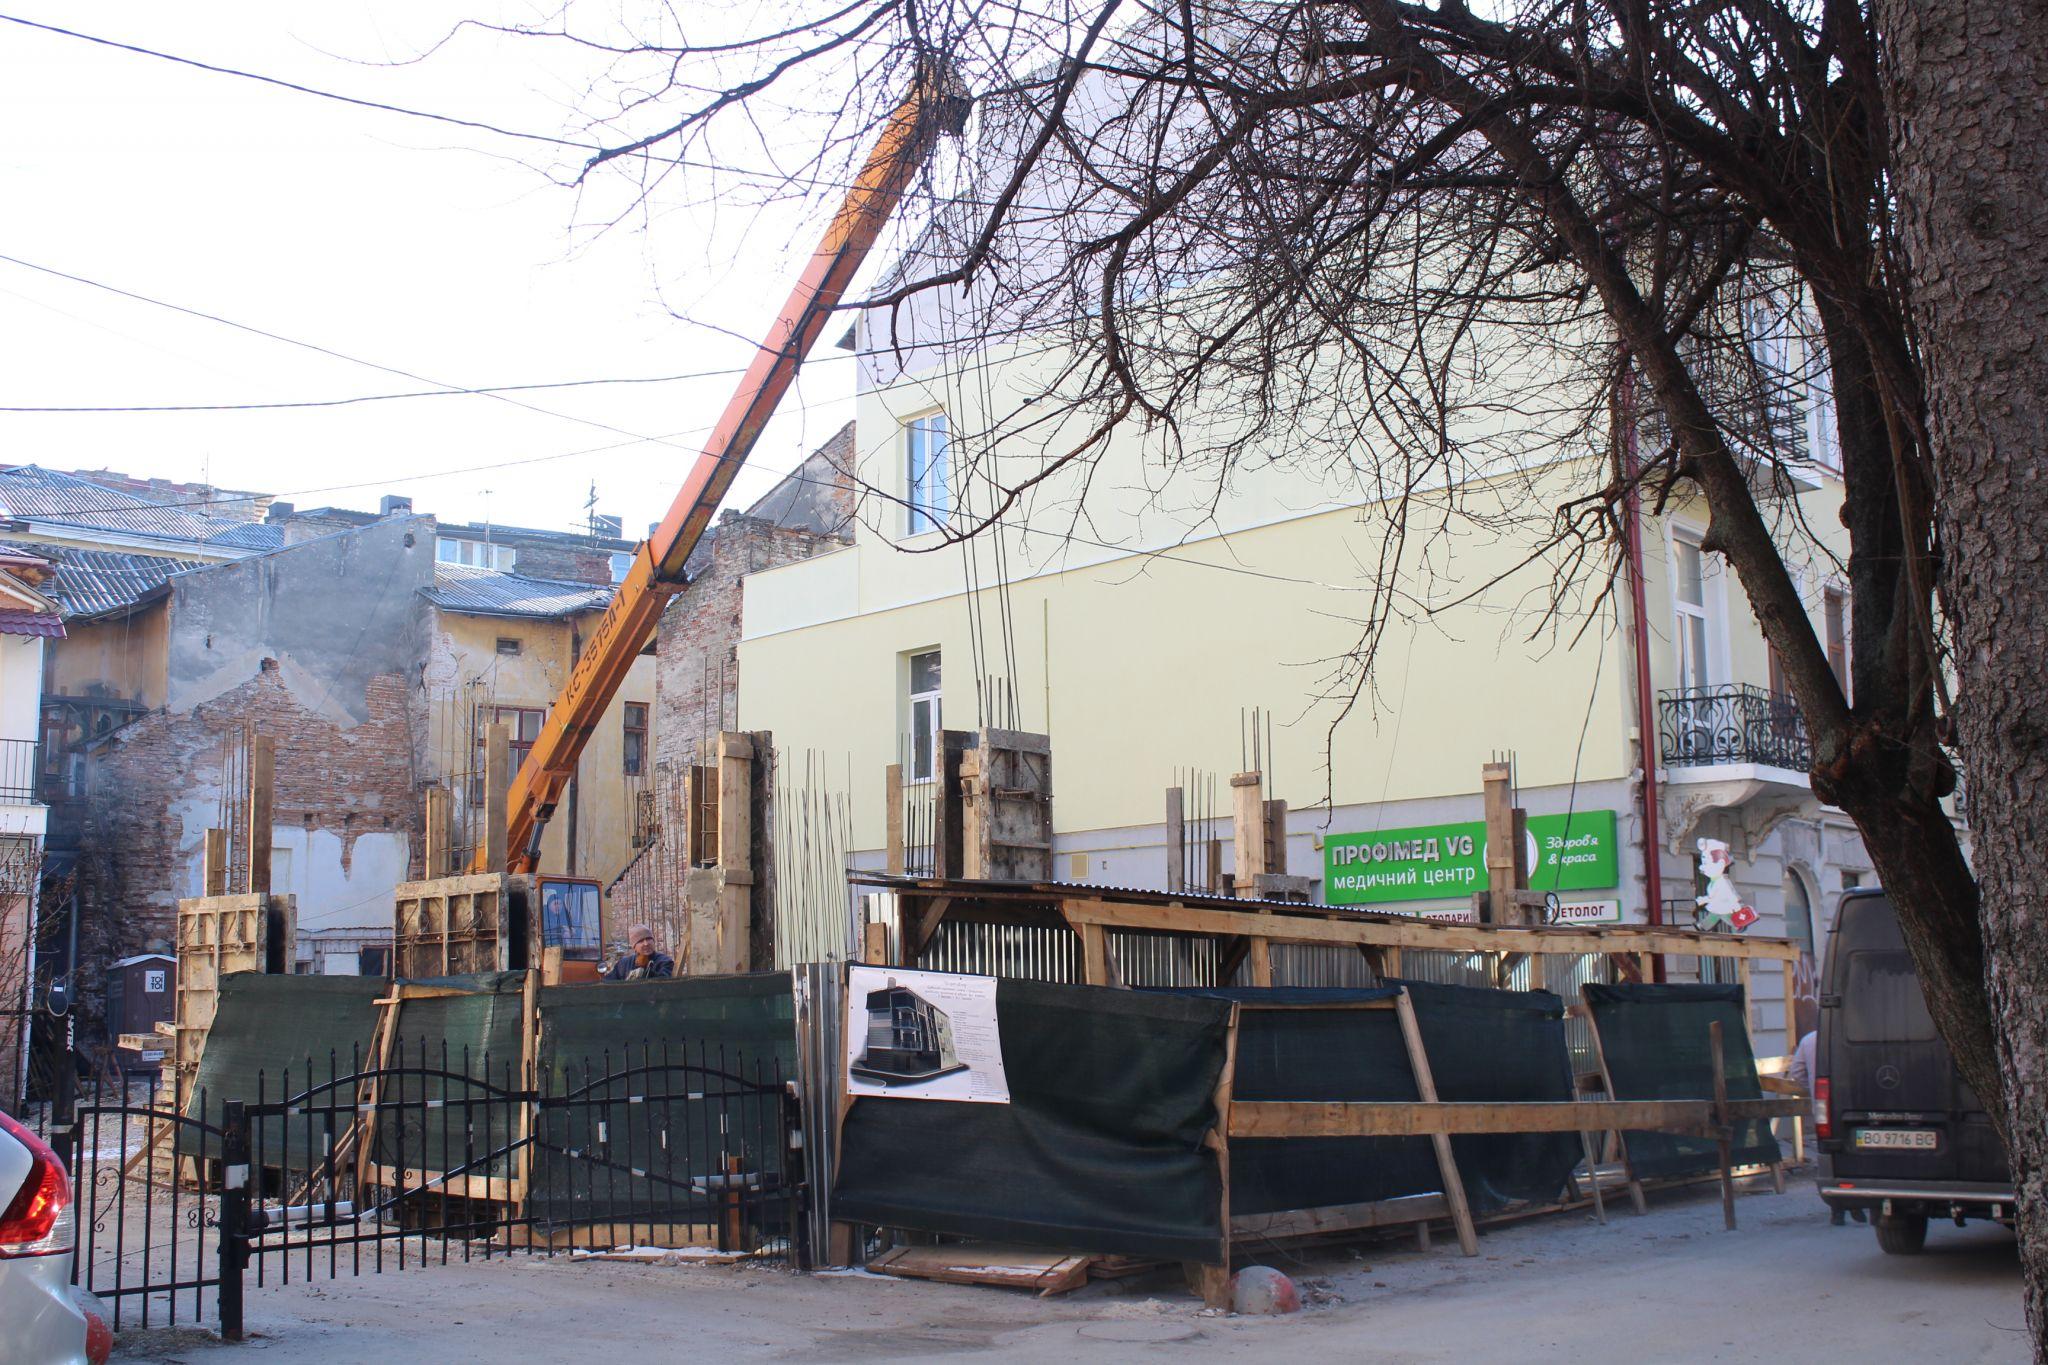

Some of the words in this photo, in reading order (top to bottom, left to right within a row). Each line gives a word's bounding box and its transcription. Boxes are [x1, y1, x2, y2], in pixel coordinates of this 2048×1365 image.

[1332, 838, 1440, 866] ПРОФІМЕД
[1445, 835, 1474, 857] VG
[1548, 853, 1558, 865] &
[1561, 853, 1597, 866] краса
[1334, 868, 1417, 891] медичний
[1423, 866, 1475, 886] центр
